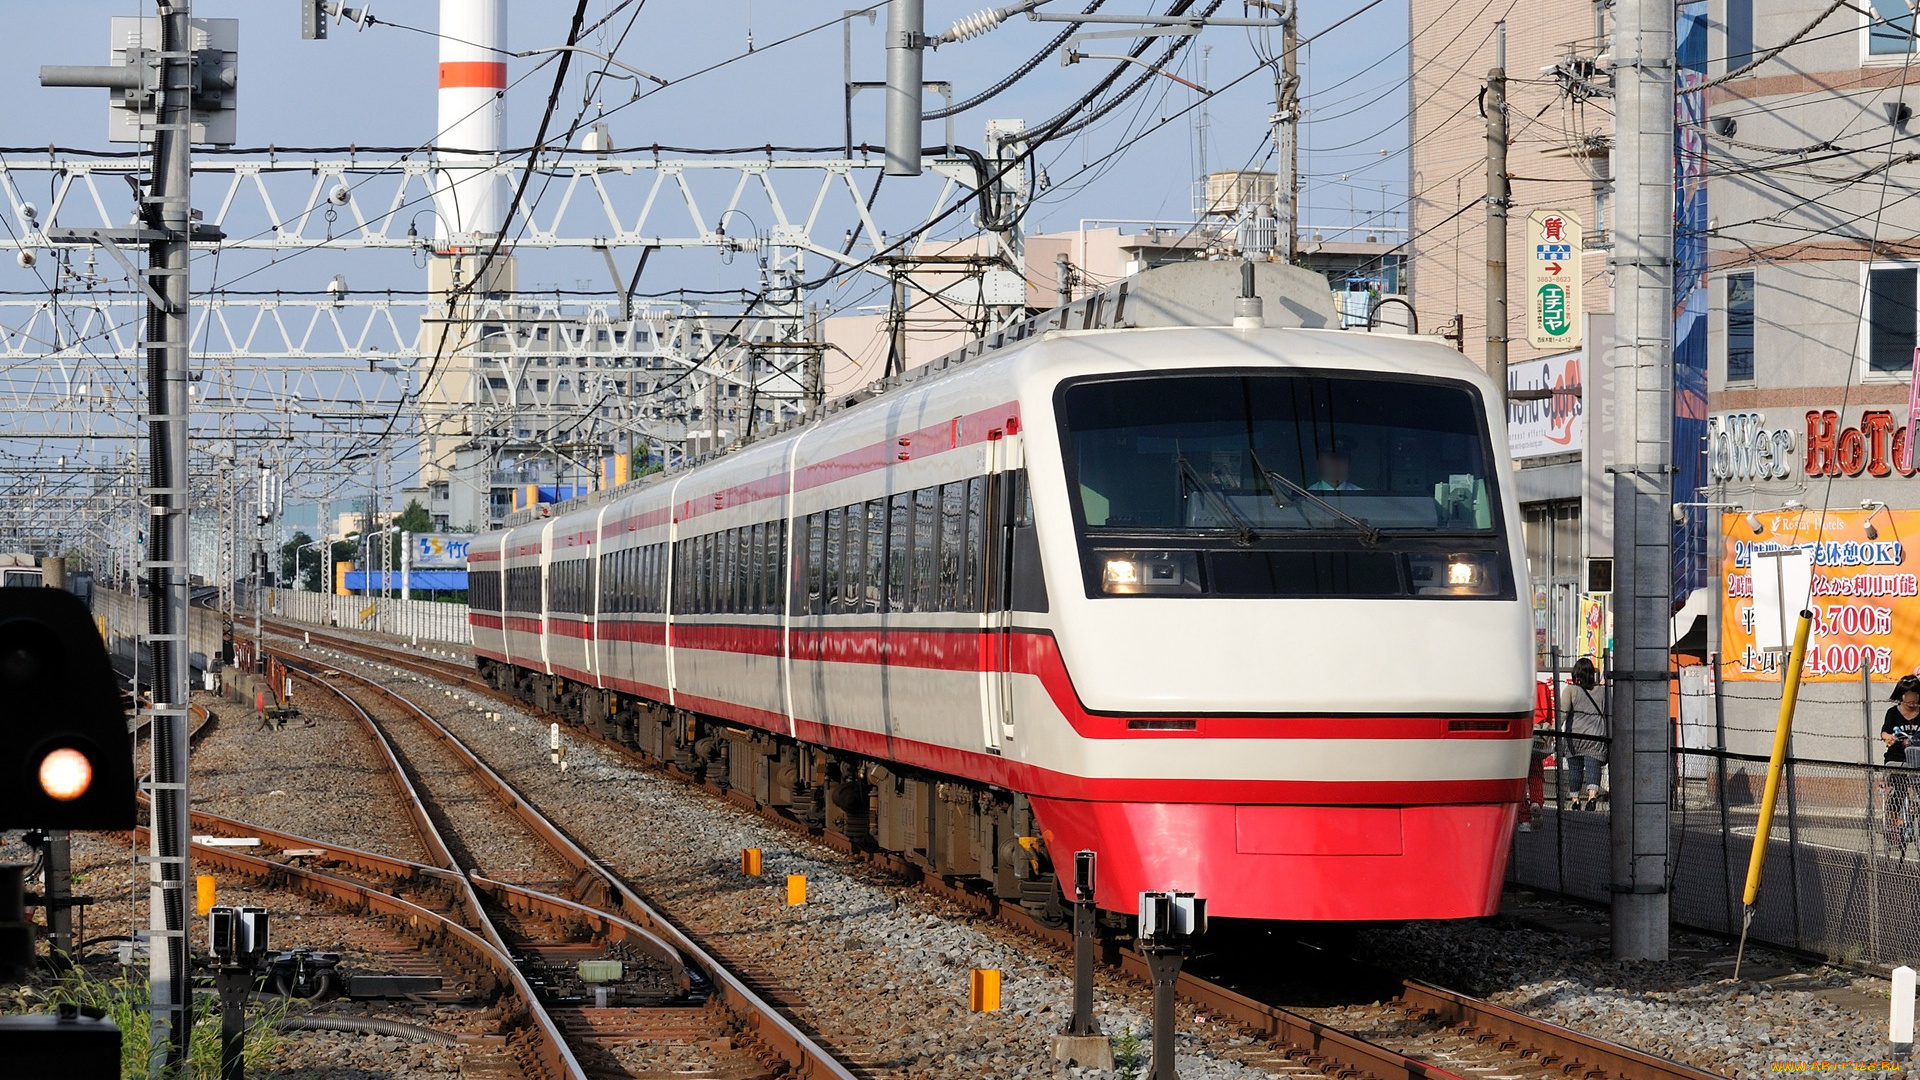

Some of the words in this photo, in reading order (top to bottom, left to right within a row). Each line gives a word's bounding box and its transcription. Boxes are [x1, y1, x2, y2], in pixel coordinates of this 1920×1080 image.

[1545, 217, 1562, 240] 質
[1544, 288, 1563, 331] エチゴヤ
